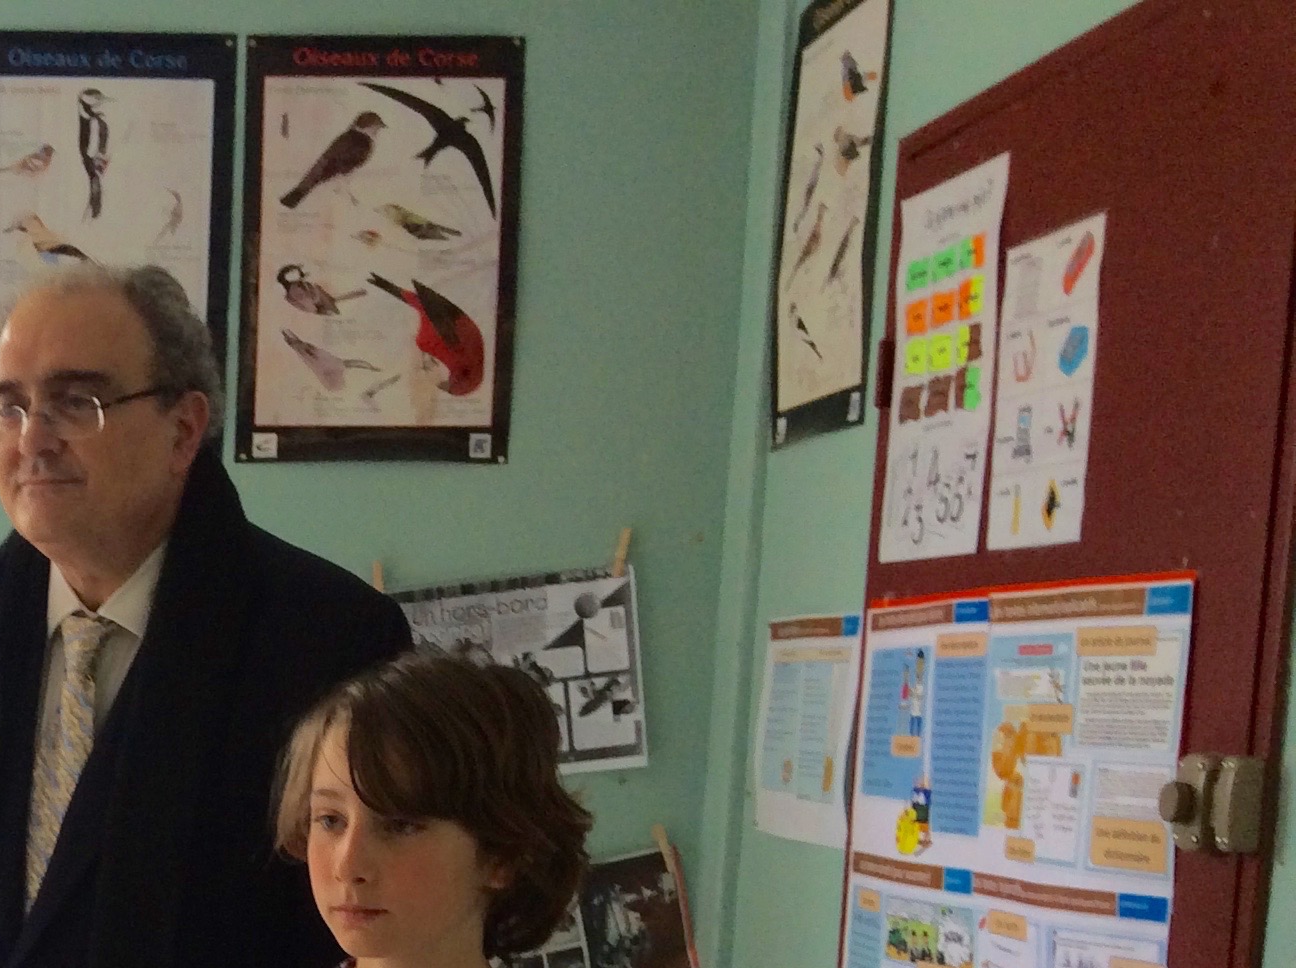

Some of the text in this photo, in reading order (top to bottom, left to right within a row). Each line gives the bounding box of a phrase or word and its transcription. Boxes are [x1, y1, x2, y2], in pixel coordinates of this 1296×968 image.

[8, 47, 187, 69] Oiseaux de Corse
[292, 47, 478, 67] Oiseaux de Corse
